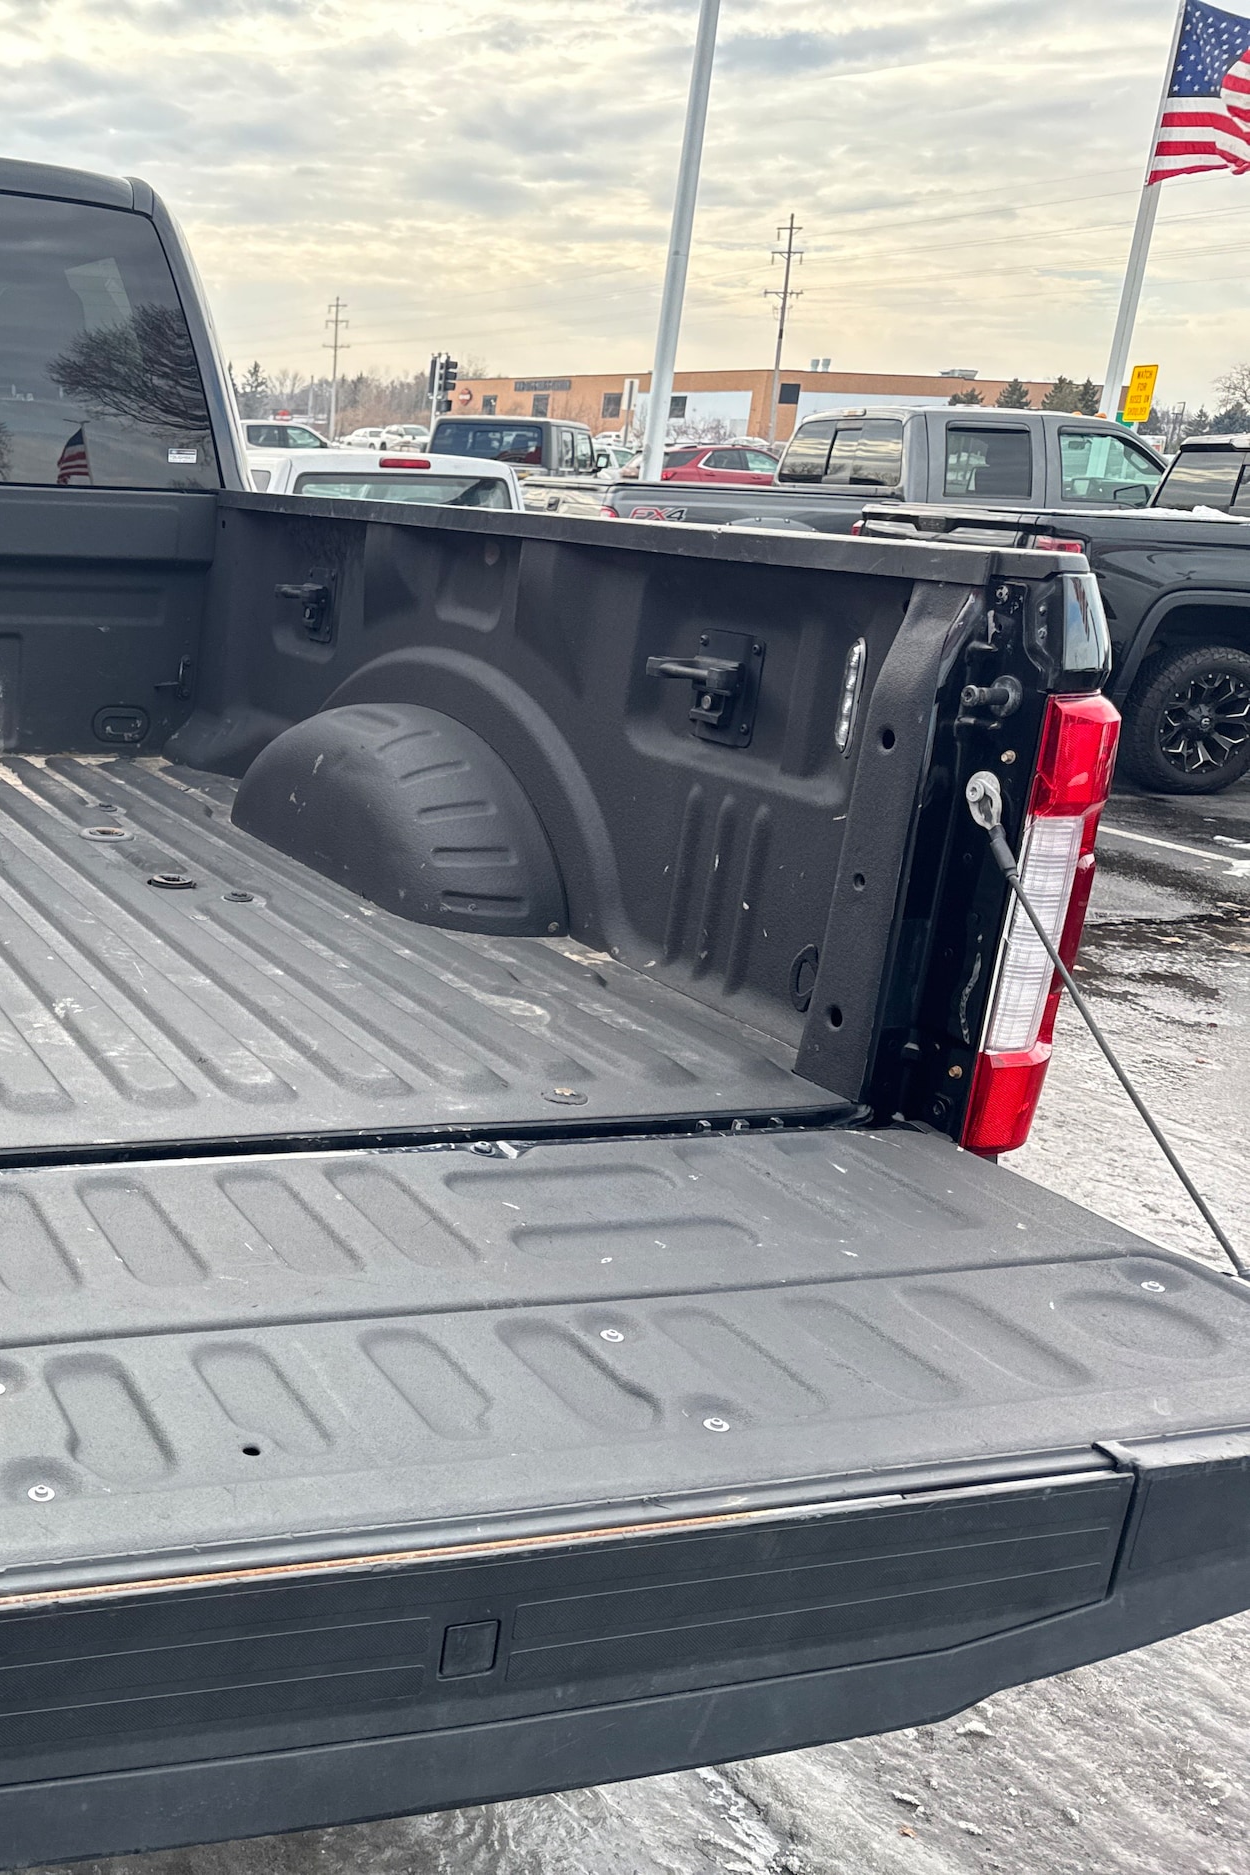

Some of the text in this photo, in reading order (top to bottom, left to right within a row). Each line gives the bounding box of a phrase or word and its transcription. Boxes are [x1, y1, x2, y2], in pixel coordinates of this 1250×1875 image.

[1137, 369, 1153, 379] WATCH
[1137, 382, 1147, 391] FOR
[630, 506, 688, 521] FX4
